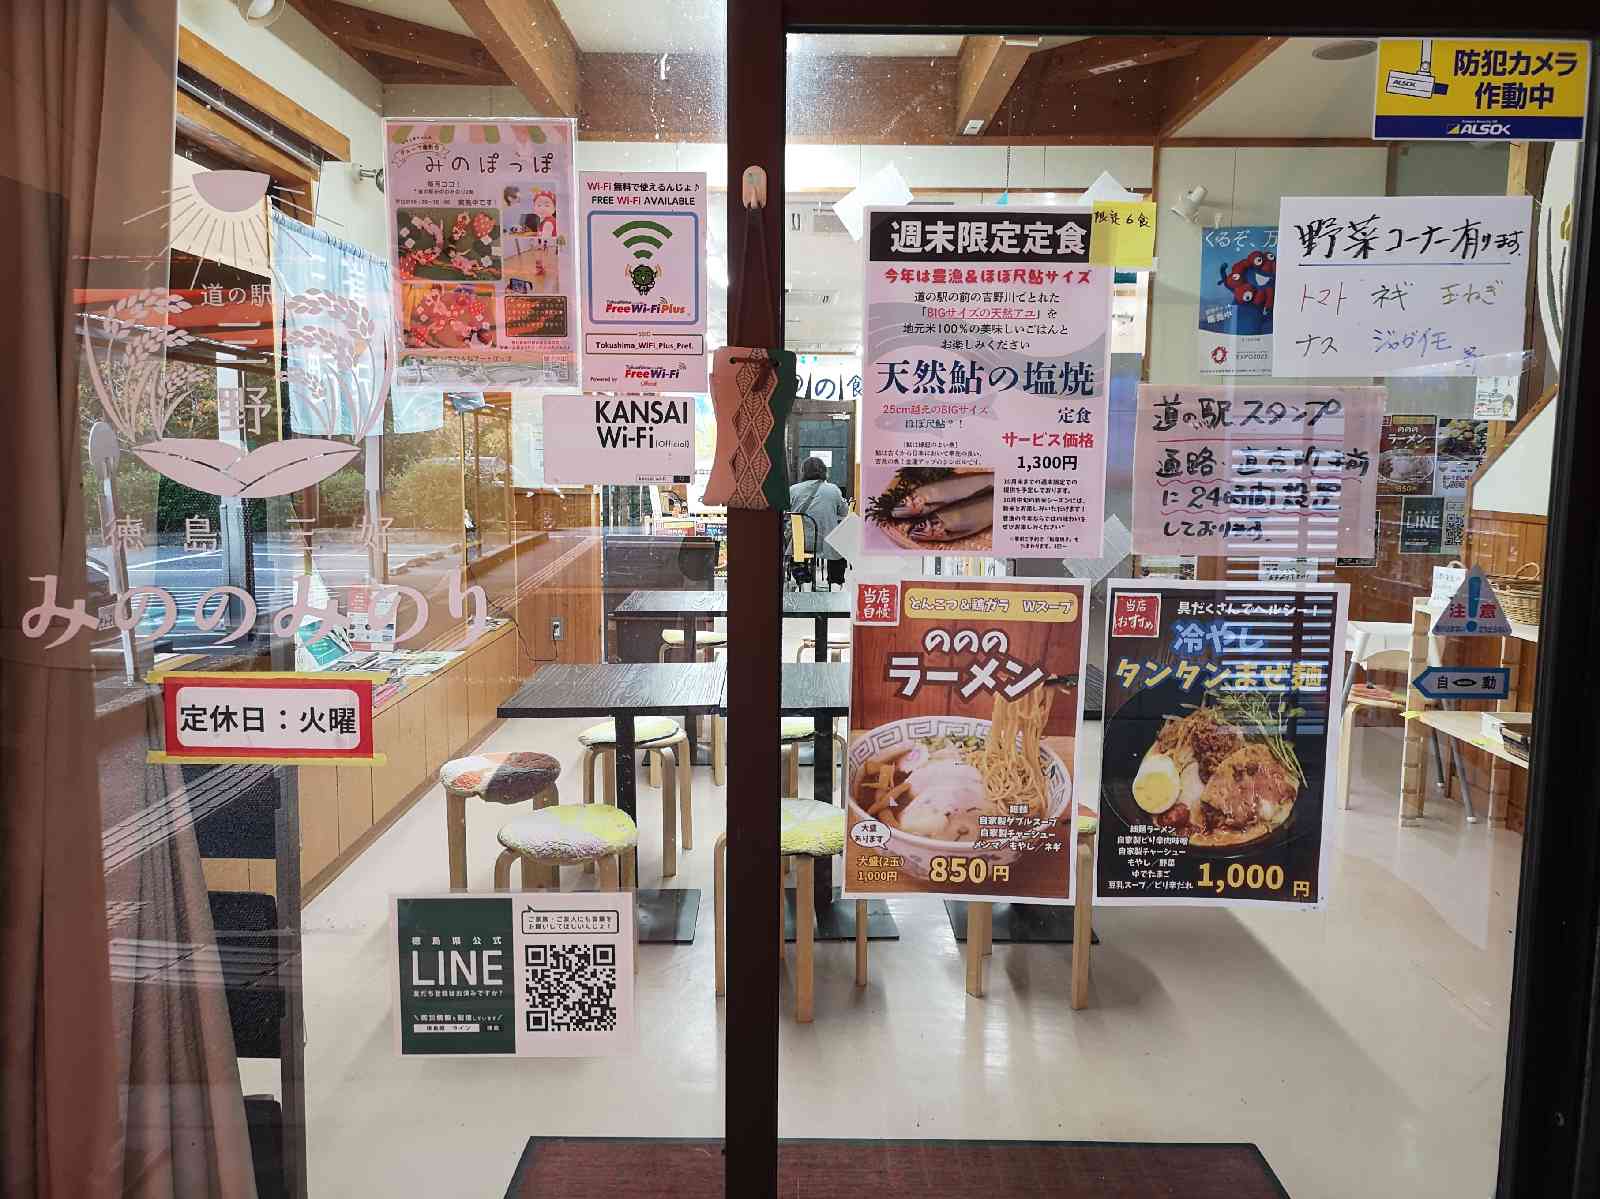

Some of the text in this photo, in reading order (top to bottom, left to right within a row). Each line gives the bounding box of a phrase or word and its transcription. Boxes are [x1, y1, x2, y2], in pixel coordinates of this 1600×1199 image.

[1453, 50, 1578, 77] 防犯カメラ
[1392, 79, 1416, 88] ALSOK
[1474, 82, 1554, 110] 作動中
[1461, 124, 1511, 136] ALSOK
[425, 152, 554, 174] みのぽっぽ
[587, 182, 611, 191] Wi-Fi
[591, 196, 614, 205] FREE
[643, 197, 696, 206] AVAILABLE
[891, 220, 1087, 255] 週末限定定食
[200, 283, 273, 305] 道の駅
[914, 291, 1060, 303] 道の駅の前の吉野川でとれた
[1301, 281, 1347, 315] トマト
[1371, 281, 1416, 310] ネギ
[941, 338, 1031, 351] お楽しみください
[1296, 334, 1338, 357] ナス
[875, 359, 1095, 396] 天然鮎の塩焼
[595, 401, 688, 424] KANSAI
[1057, 407, 1092, 424] 定食
[597, 426, 689, 449] Wi-Fi (Official)
[1002, 432, 1094, 449] サービス価格
[1017, 456, 1078, 472] 1,300円
[112, 514, 392, 553] 徳島三好
[864, 589, 890, 604] 当店
[22, 572, 488, 650] みののみのり
[863, 605, 890, 619] 自慢
[1023, 600, 1073, 614] Wスープ
[1126, 600, 1147, 612] 当店
[1449, 602, 1497, 618] 注意
[1115, 614, 1154, 631] おすすめ
[925, 629, 1009, 655] ののの
[1173, 622, 1264, 654] 冷やし
[889, 656, 1044, 699] ラーメン
[1116, 658, 1323, 690] タンタンまぜ麺
[1437, 677, 1496, 690] 自動
[180, 704, 357, 734] 定休日：火曜
[979, 816, 1057, 826] 自家製ダブルスープ
[855, 835, 883, 843] あります
[980, 828, 1056, 838] 自家製チャーシュー
[1118, 847, 1187, 856] 自家製チャーシュー
[858, 871, 897, 883] 1,000円
[930, 857, 1010, 884] 850円
[1131, 870, 1171, 878] ゆでたまご
[411, 936, 502, 945] 徳島県公式
[412, 950, 503, 986] LINE
